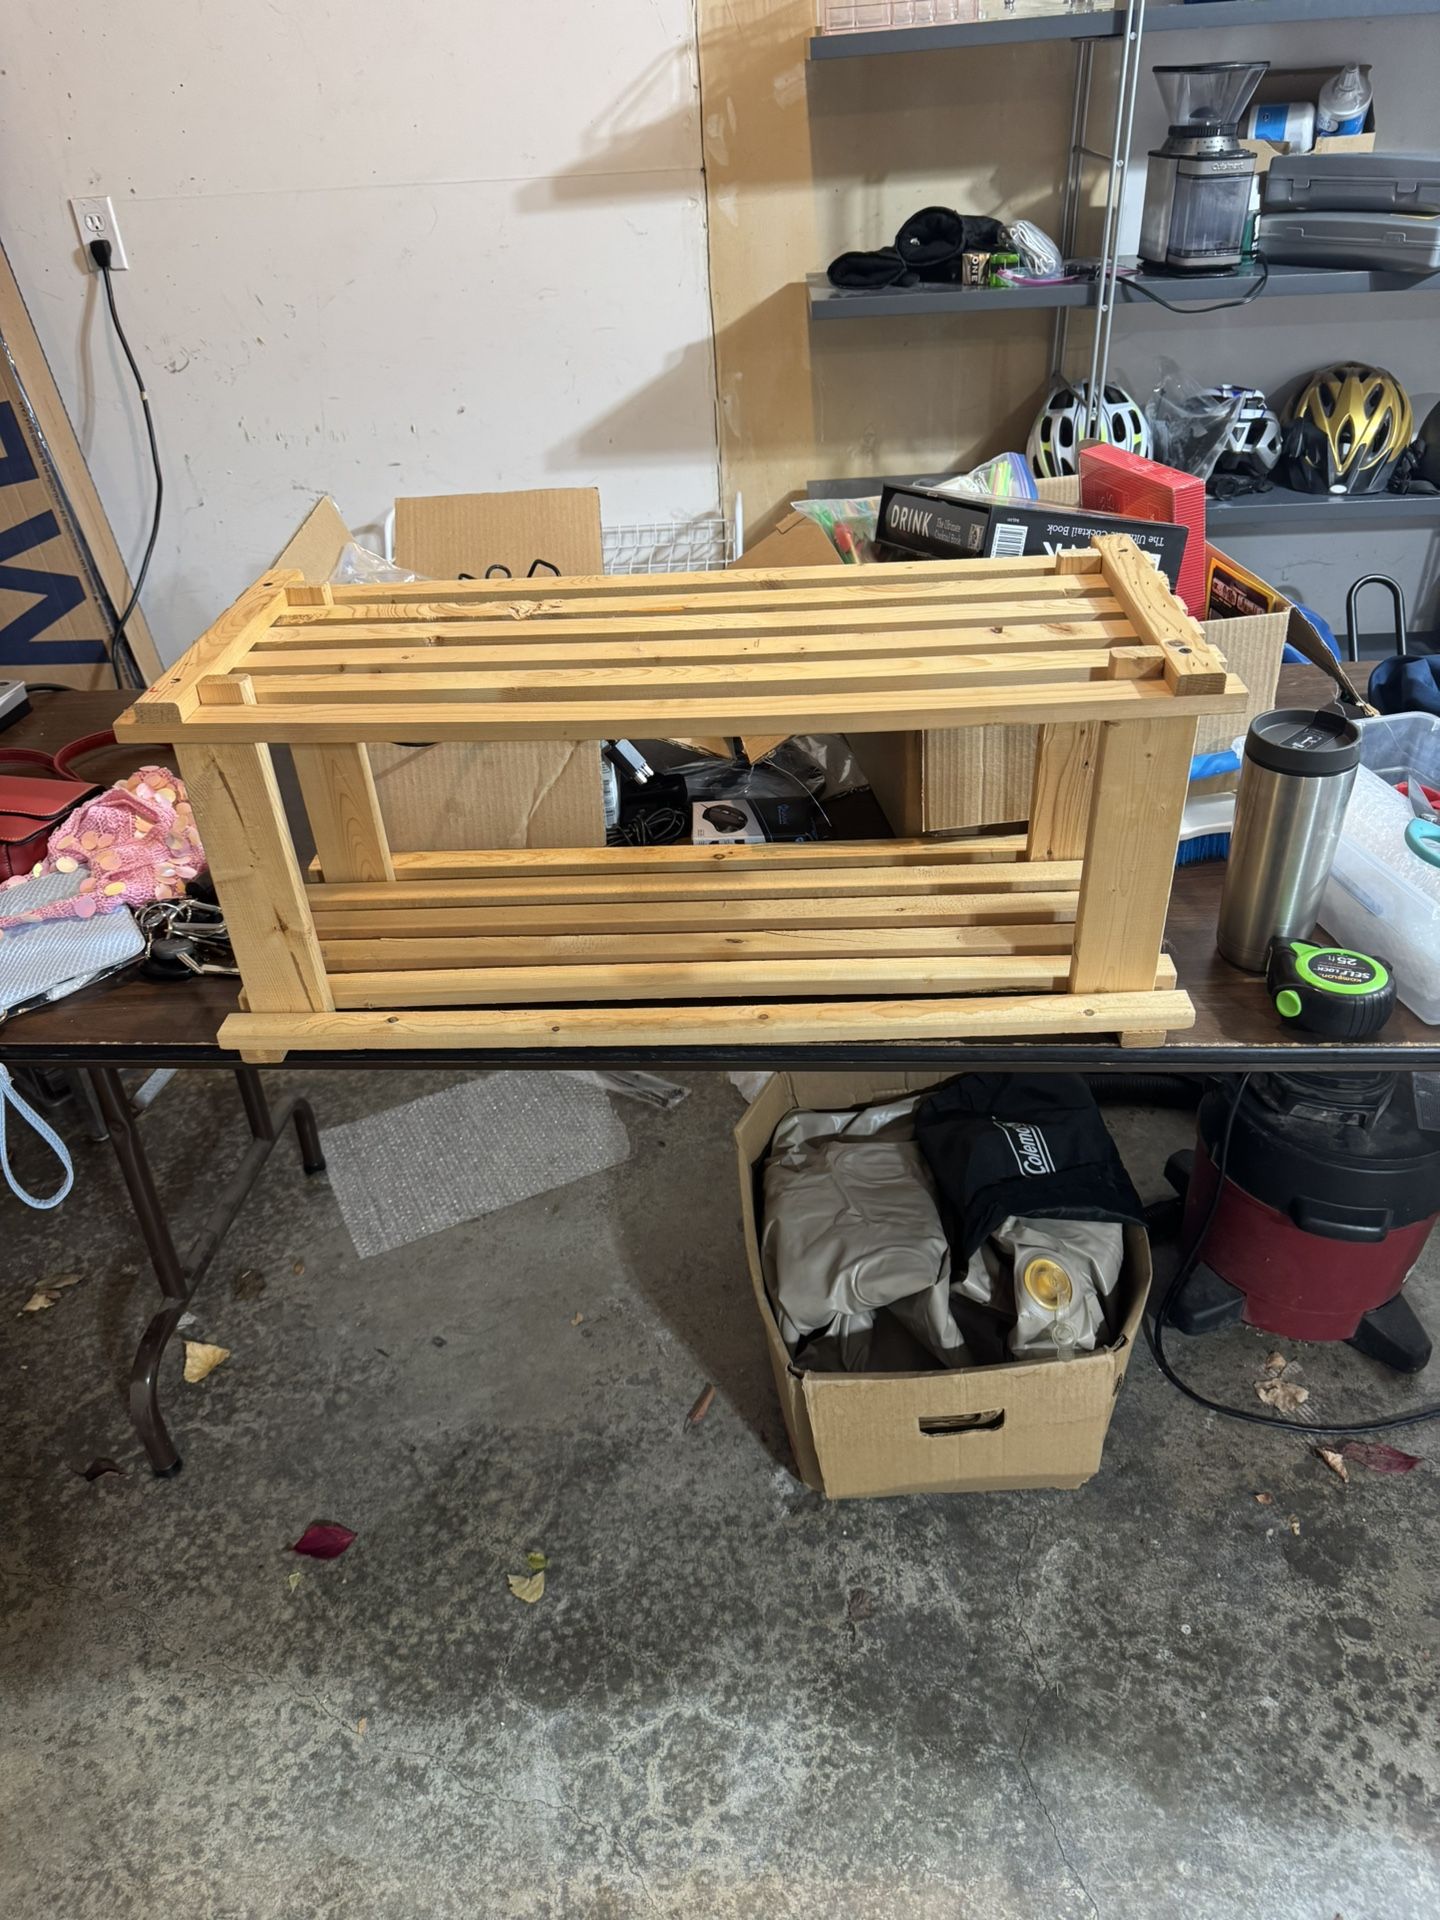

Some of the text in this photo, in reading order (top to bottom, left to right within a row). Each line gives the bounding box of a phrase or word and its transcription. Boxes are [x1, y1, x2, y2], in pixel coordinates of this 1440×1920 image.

[890, 504, 933, 538] DRINK
[1046, 524, 1070, 536] Book
[1148, 535, 1164, 547] The
[1337, 956, 1358, 966] 25
[1340, 970, 1371, 979] SELF
